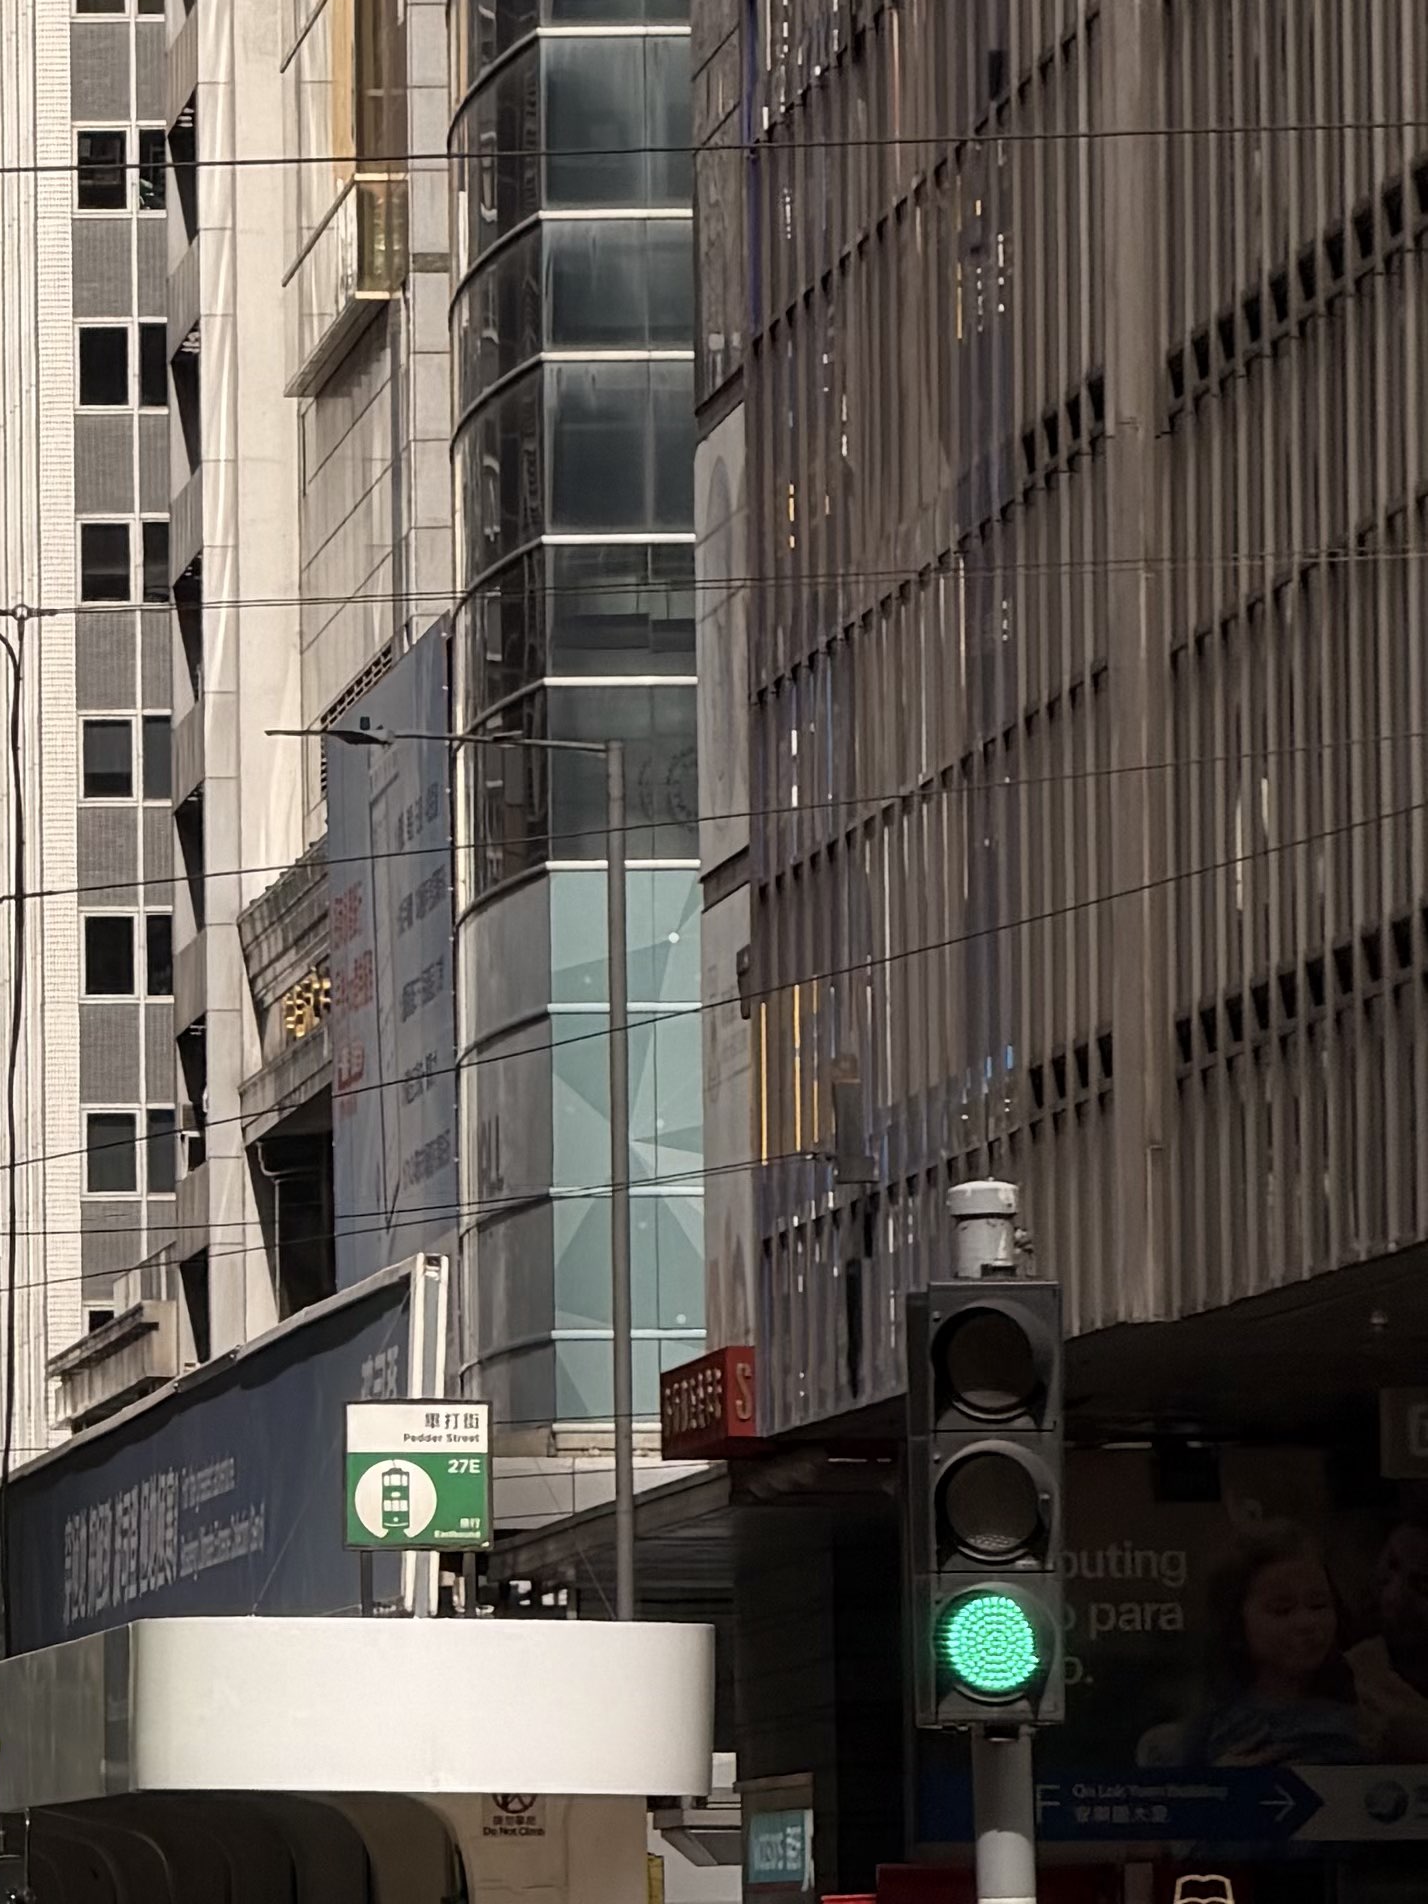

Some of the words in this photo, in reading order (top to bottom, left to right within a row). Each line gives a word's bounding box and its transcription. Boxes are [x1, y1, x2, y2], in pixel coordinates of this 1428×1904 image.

[425, 1413, 479, 1430] 畢打街
[404, 1433, 443, 1443] Pedder
[446, 1433, 480, 1443] Street
[448, 1459, 480, 1473] 27E
[1089, 1601, 1185, 1640] para
